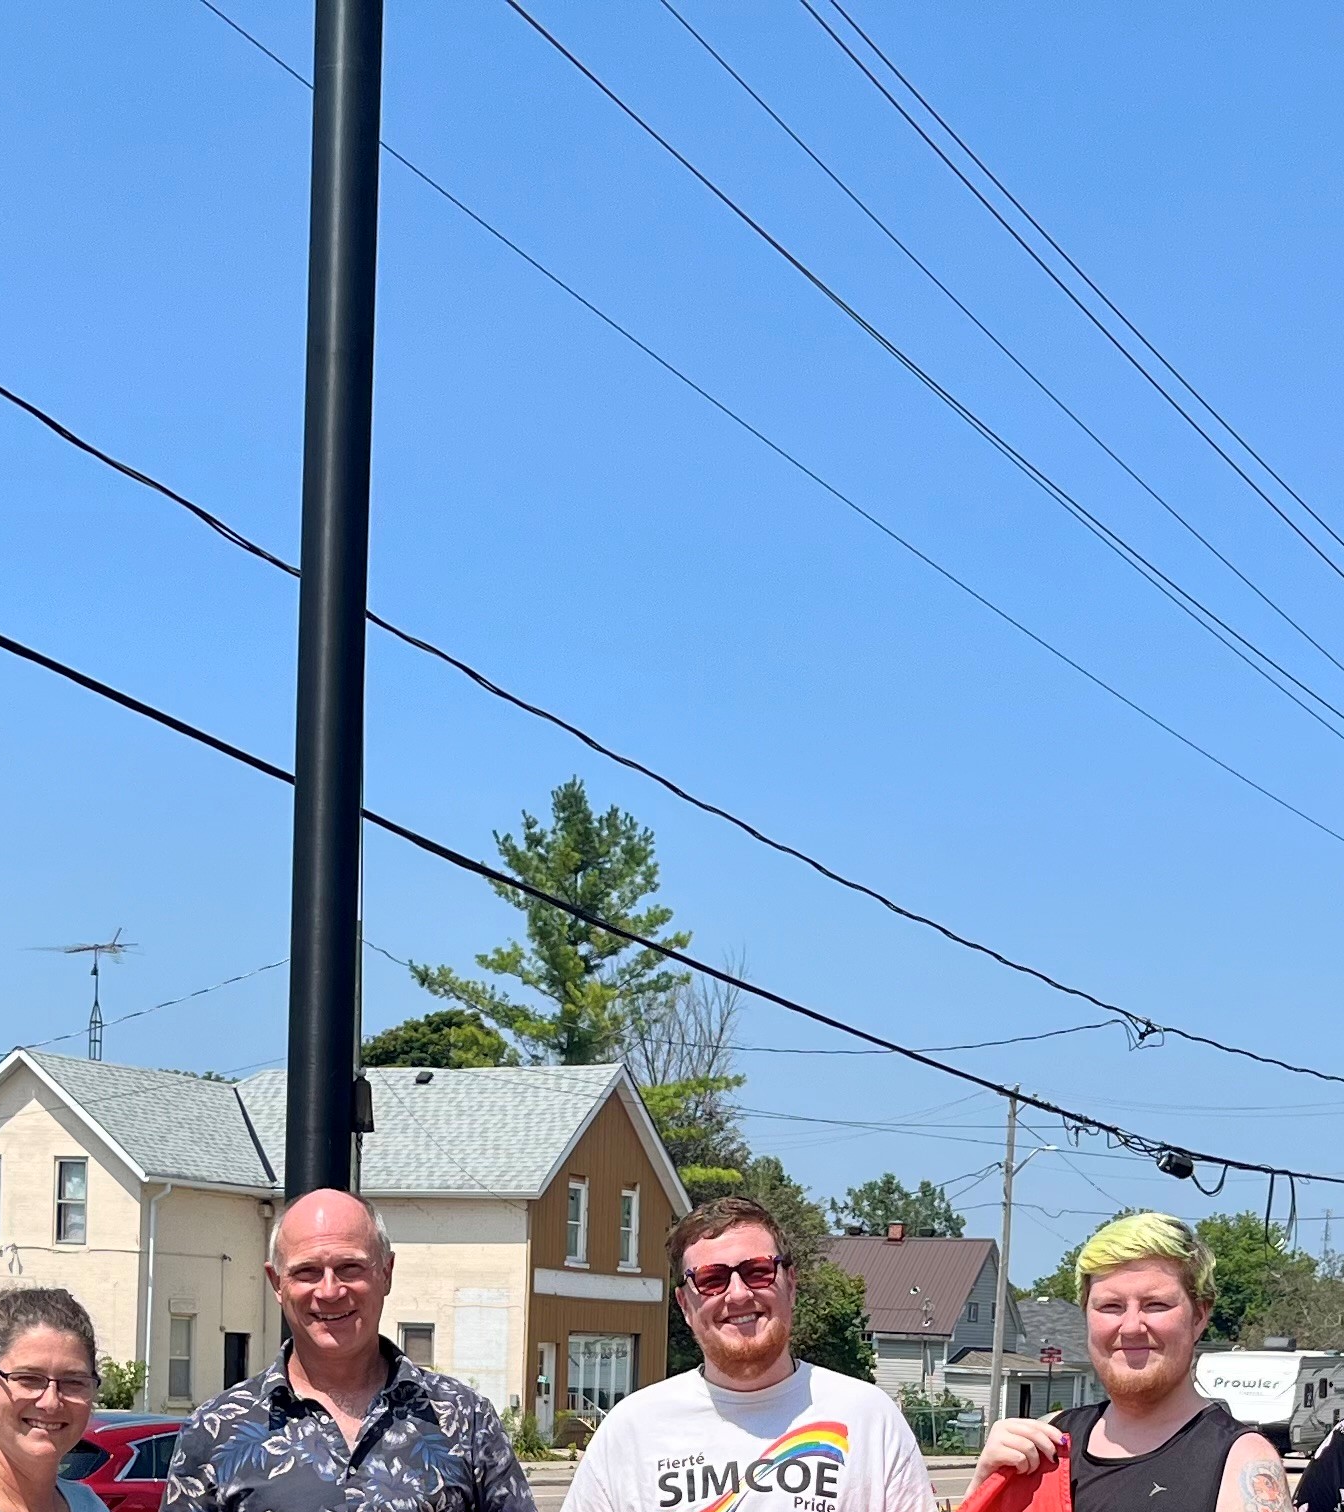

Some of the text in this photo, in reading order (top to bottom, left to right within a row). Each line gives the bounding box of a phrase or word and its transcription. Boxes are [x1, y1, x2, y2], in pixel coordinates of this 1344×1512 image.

[1213, 1377, 1280, 1389] Prowler
[657, 1452, 705, 1471] Fierté
[658, 1458, 839, 1508] SIMCOE
